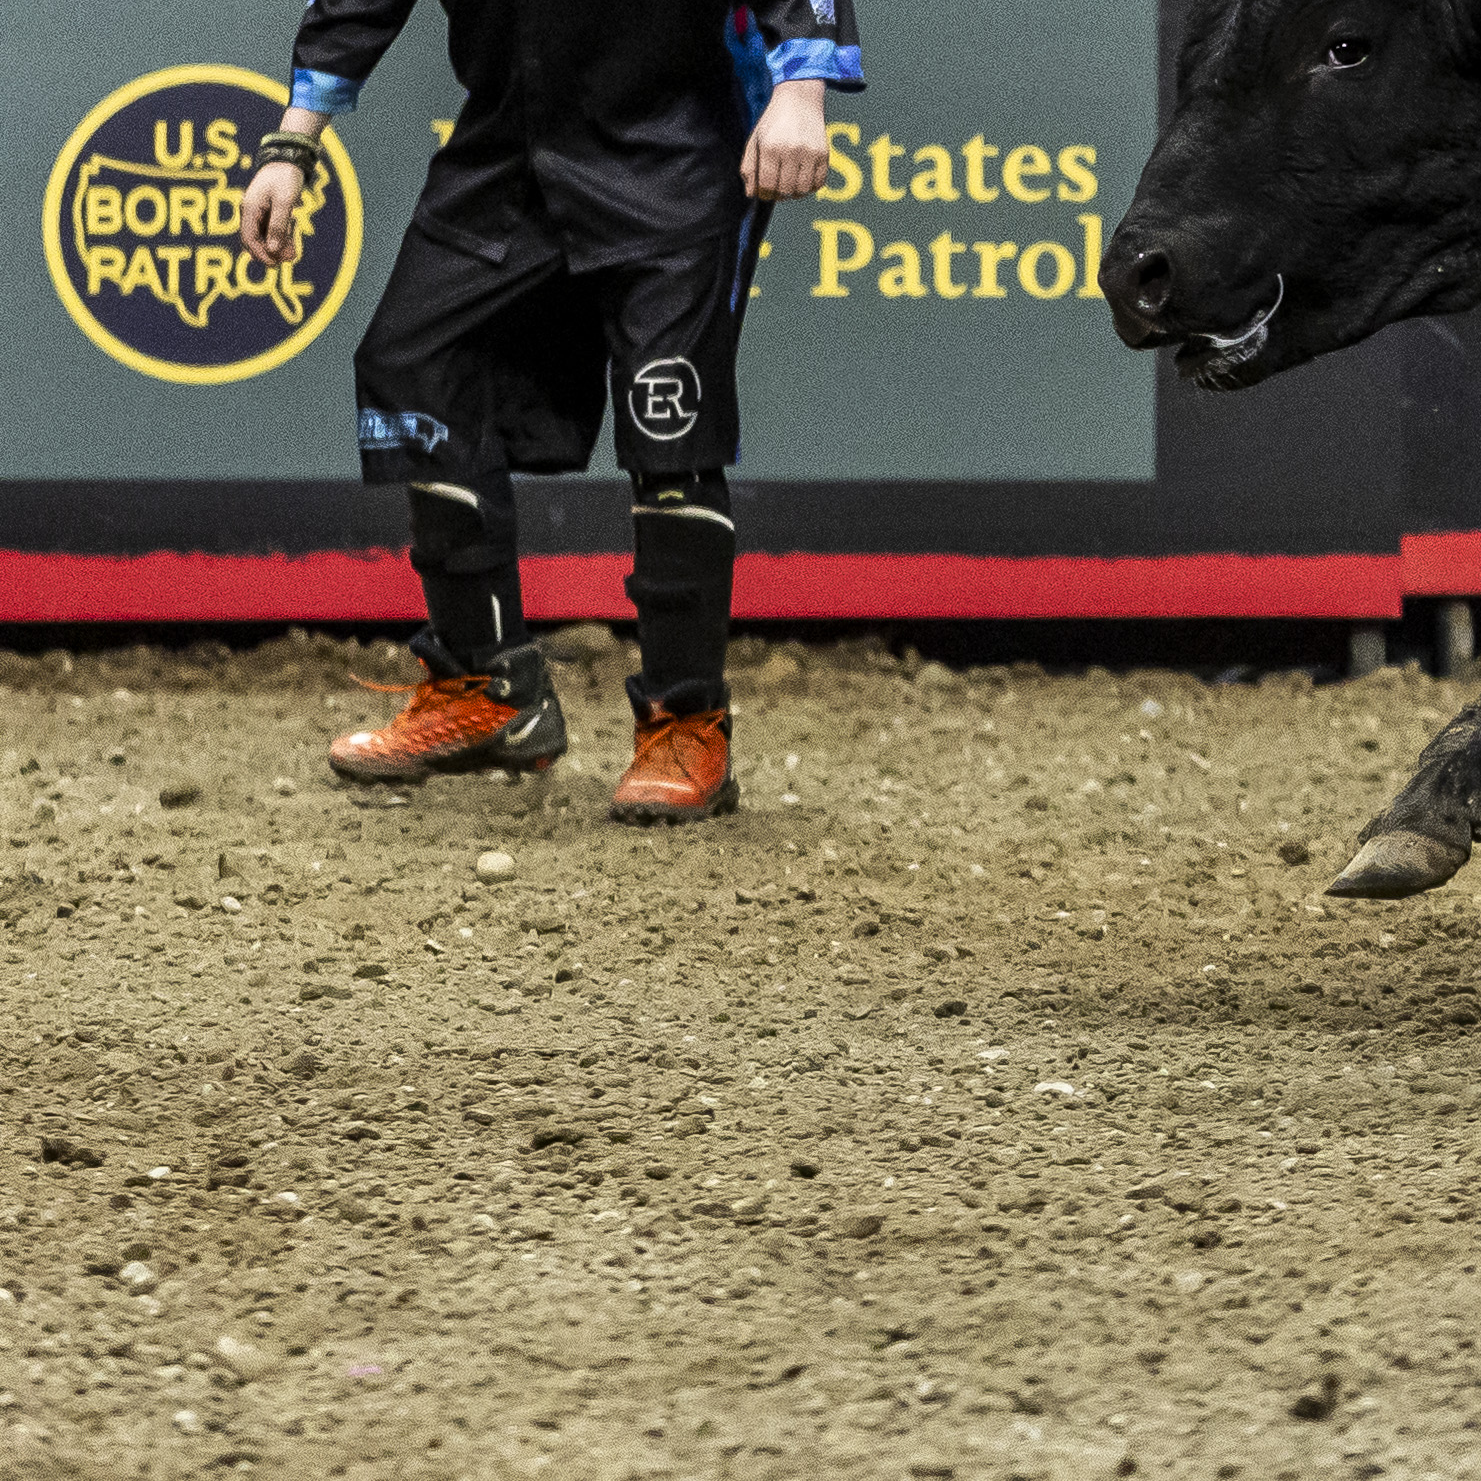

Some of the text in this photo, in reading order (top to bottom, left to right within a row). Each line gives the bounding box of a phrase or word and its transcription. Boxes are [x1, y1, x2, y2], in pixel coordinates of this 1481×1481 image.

[154, 119, 253, 168] U.S.
[814, 121, 1100, 202] States
[811, 213, 1105, 299] Patrol
